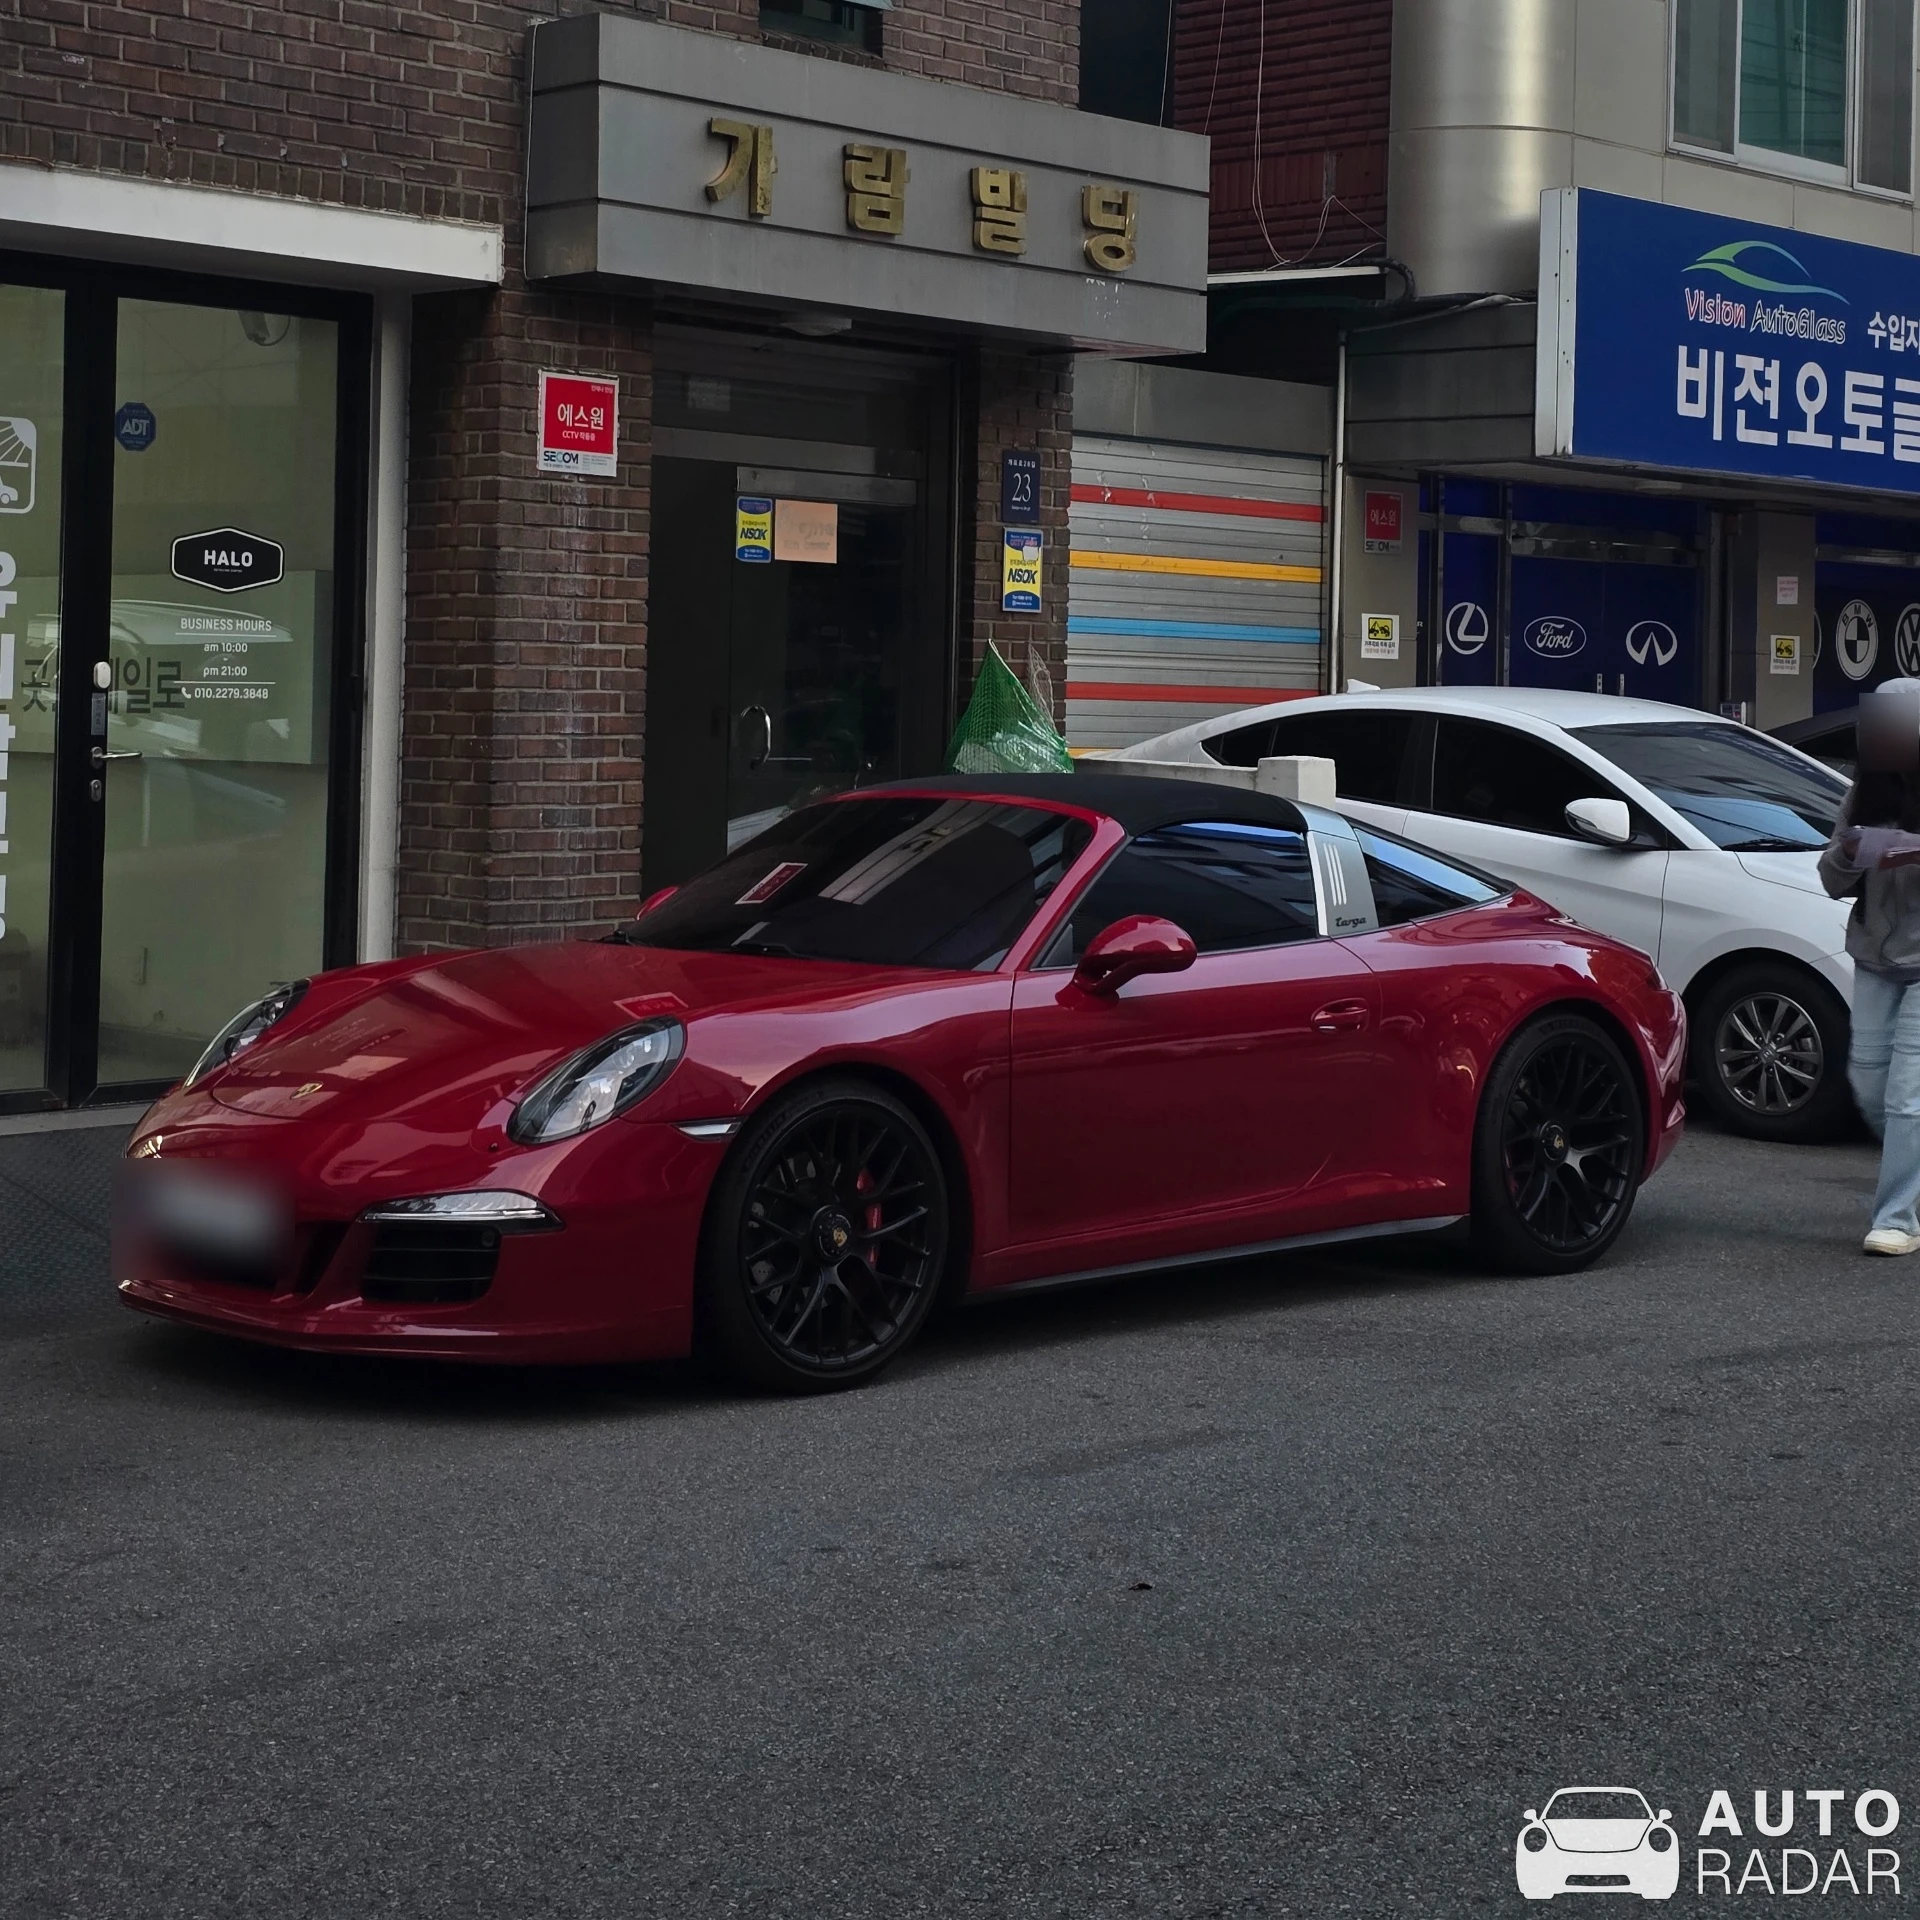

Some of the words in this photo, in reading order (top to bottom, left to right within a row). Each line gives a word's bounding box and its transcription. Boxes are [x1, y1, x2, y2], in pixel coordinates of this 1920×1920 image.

[704, 117, 1138, 273] 가람빌딩
[1685, 288, 1746, 328] Vision
[1750, 300, 1846, 344] AutoGlass
[557, 403, 604, 430] 에스원
[121, 418, 150, 436] ADT
[562, 430, 579, 440] CCTV
[543, 450, 579, 464] SECOM
[1012, 473, 1031, 502] 23
[1370, 509, 1397, 526] 에스원
[740, 527, 768, 540] NSOK
[204, 549, 253, 567] HALO
[1007, 568, 1038, 585] NSOK
[181, 618, 233, 630] BUSINESS
[236, 620, 272, 632] HOURS
[1536, 622, 1574, 649] Ford
[204, 643, 219, 652] am
[221, 643, 248, 652] 10:00
[203, 666, 219, 677] pm
[221, 666, 248, 676] 21:00
[194, 687, 269, 699] 010.2279.3848
[1335, 917, 1367, 928] targa
